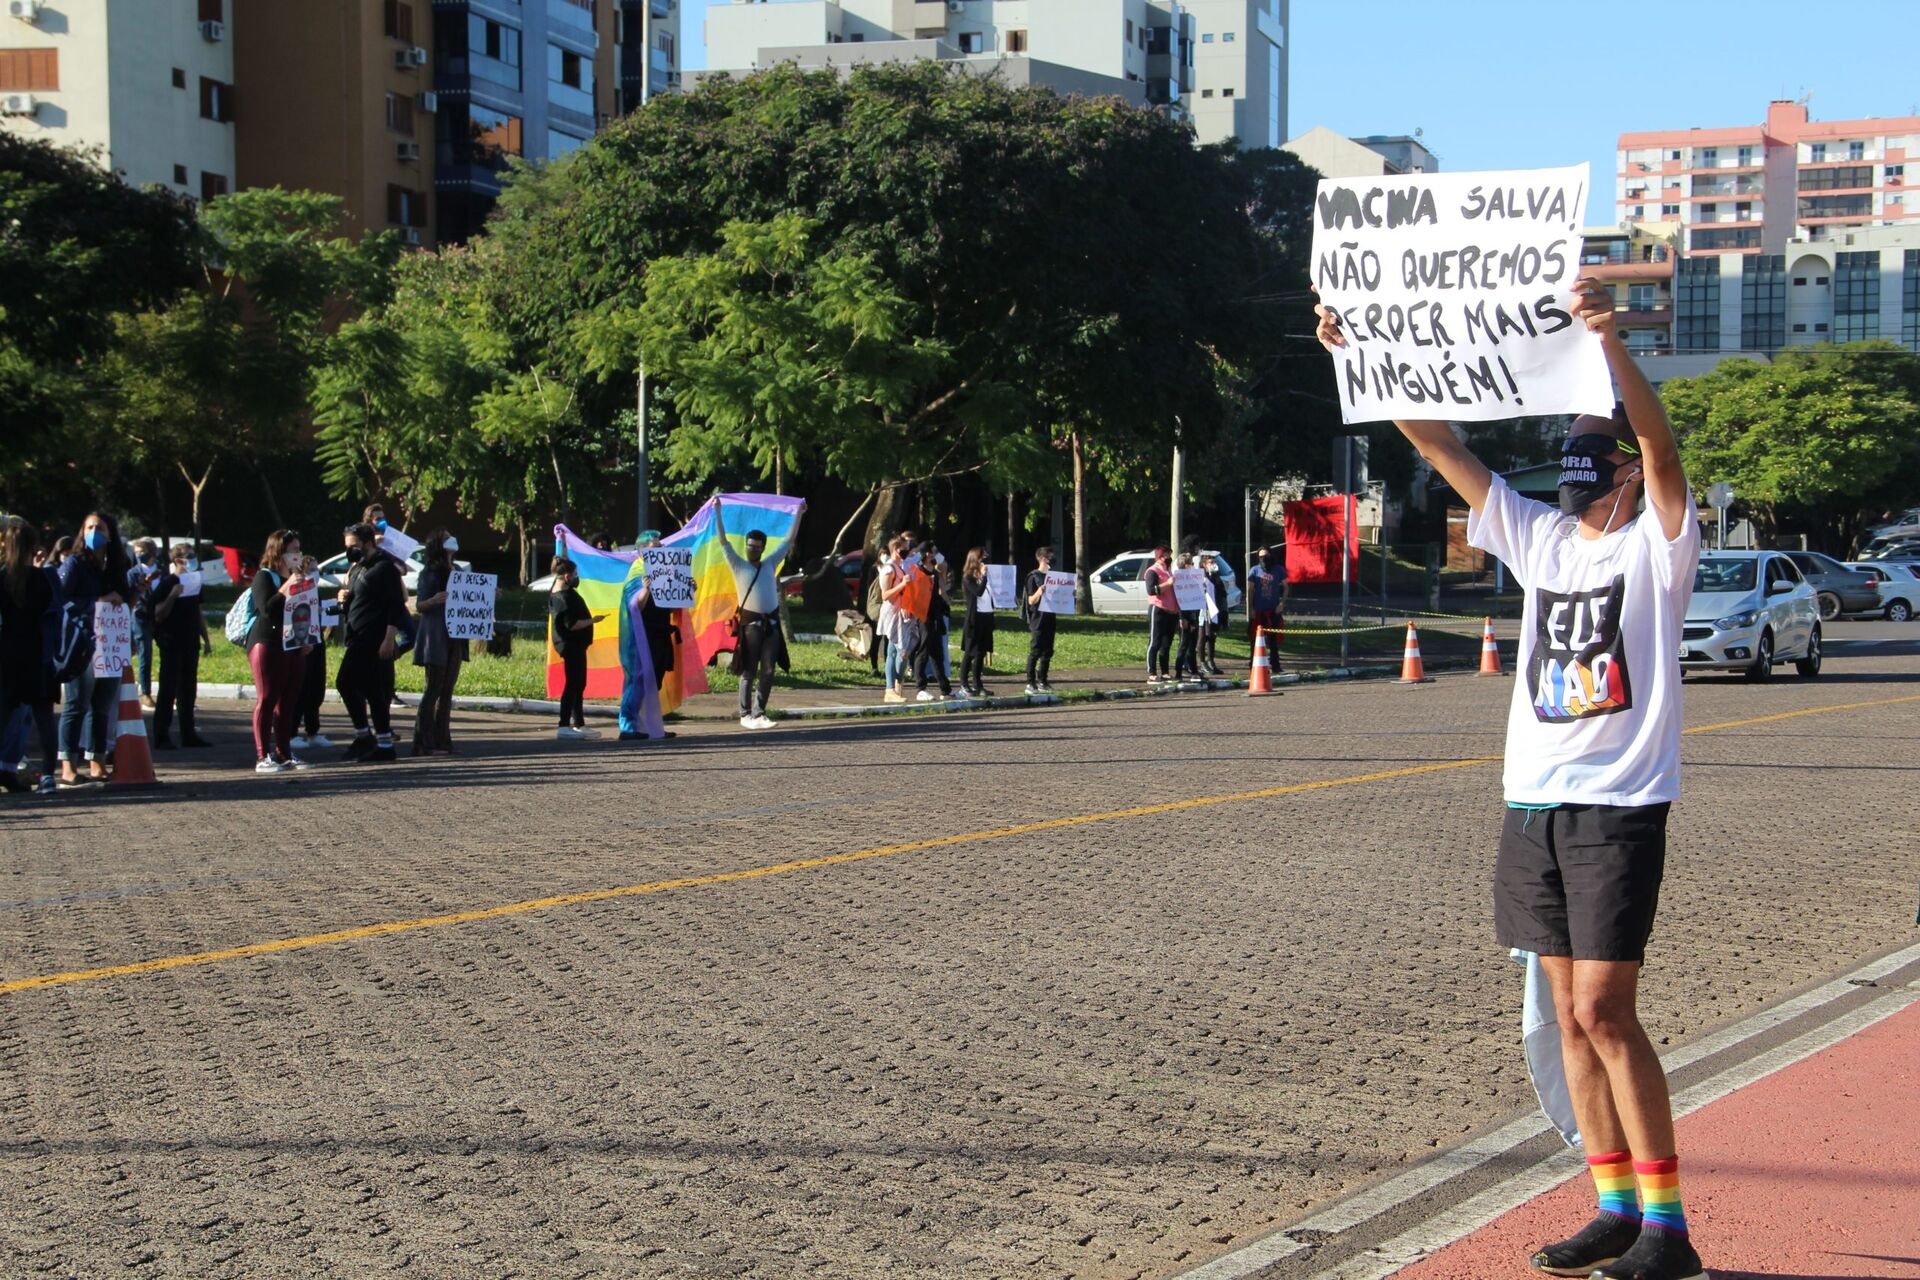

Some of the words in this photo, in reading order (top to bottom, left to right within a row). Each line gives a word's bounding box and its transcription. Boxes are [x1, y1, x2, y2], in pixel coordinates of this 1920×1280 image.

[1461, 181, 1583, 231] SALVA!
[1318, 242, 1382, 292] NÃO
[1401, 239, 1568, 293] QUEREMOS
[1463, 294, 1573, 346] MAIS
[1345, 347, 1523, 407] NINGUÉM!
[456, 624, 467, 636] DO
